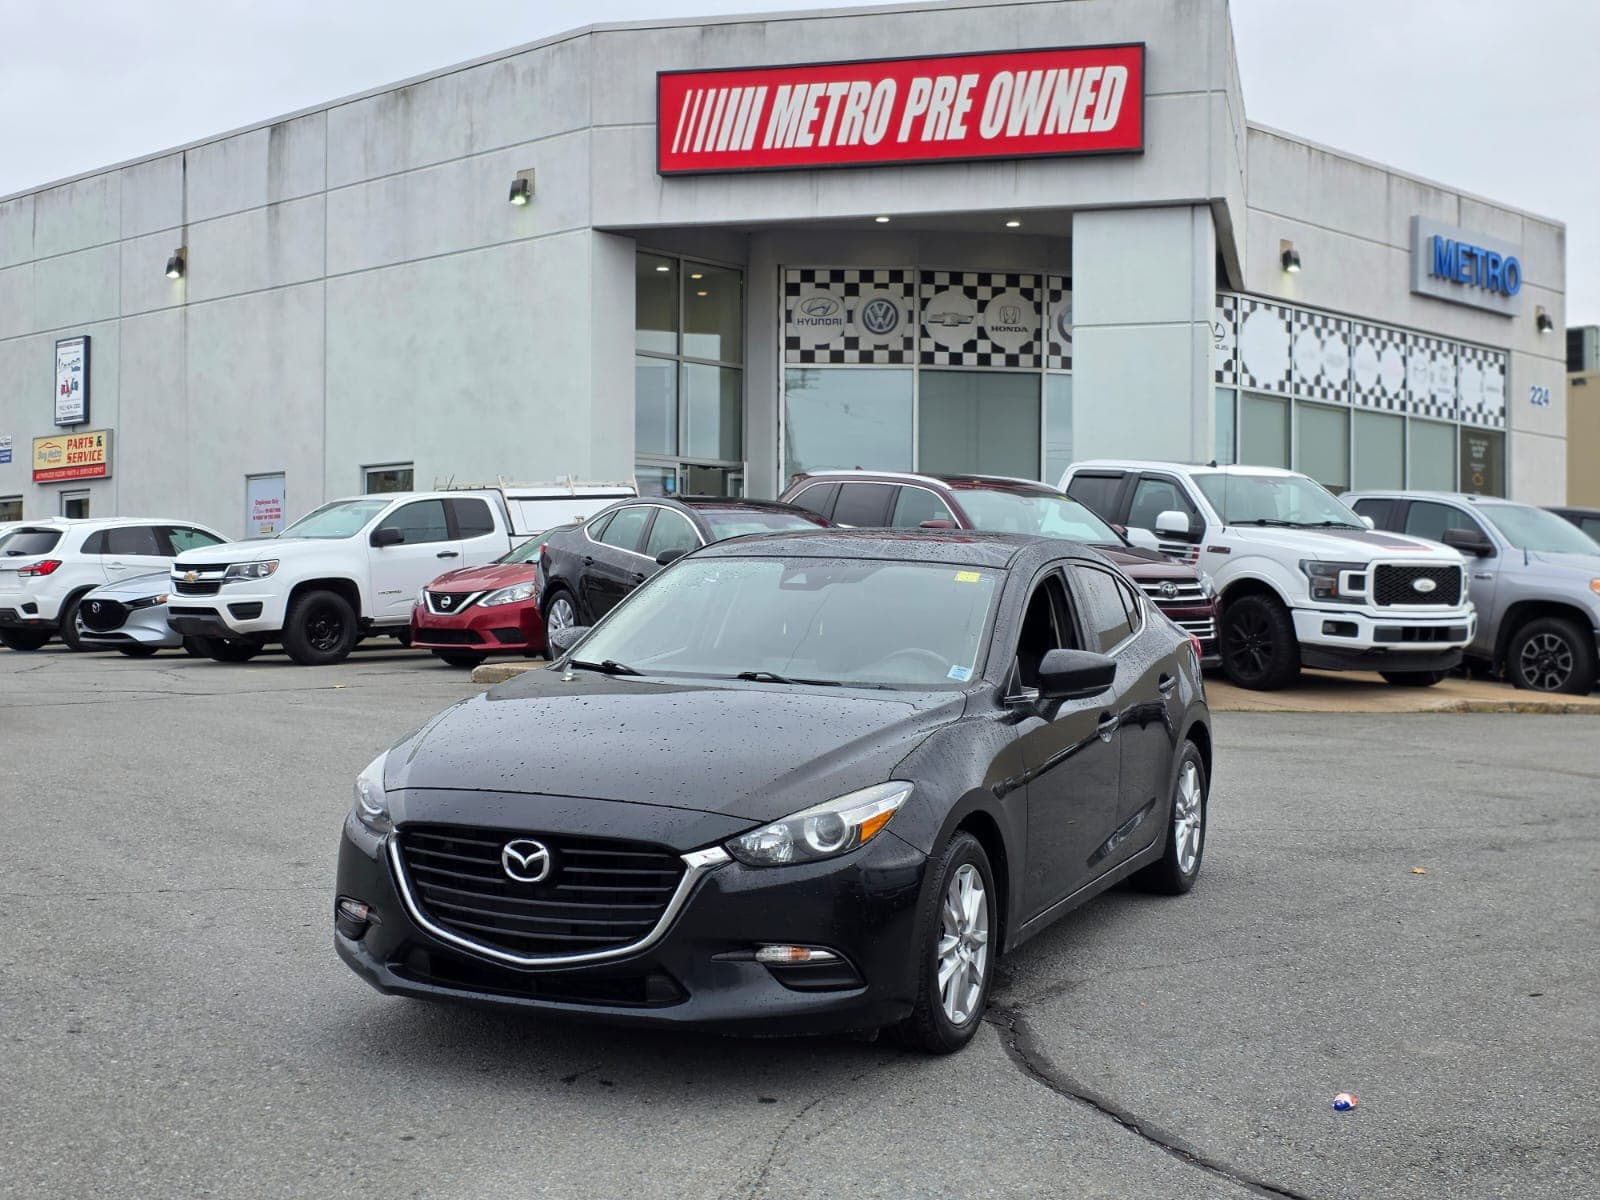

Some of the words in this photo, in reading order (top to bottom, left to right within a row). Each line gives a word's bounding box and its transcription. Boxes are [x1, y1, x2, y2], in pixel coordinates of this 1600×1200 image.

[762, 79, 896, 150] METRO
[897, 75, 980, 143] PRE
[979, 65, 1128, 139] OWNED
[1434, 234, 1521, 296] METRO
[1530, 386, 1550, 406] 224
[67, 436, 94, 449] PARTS
[96, 435, 103, 447] &
[66, 450, 103, 463] SERVICE
